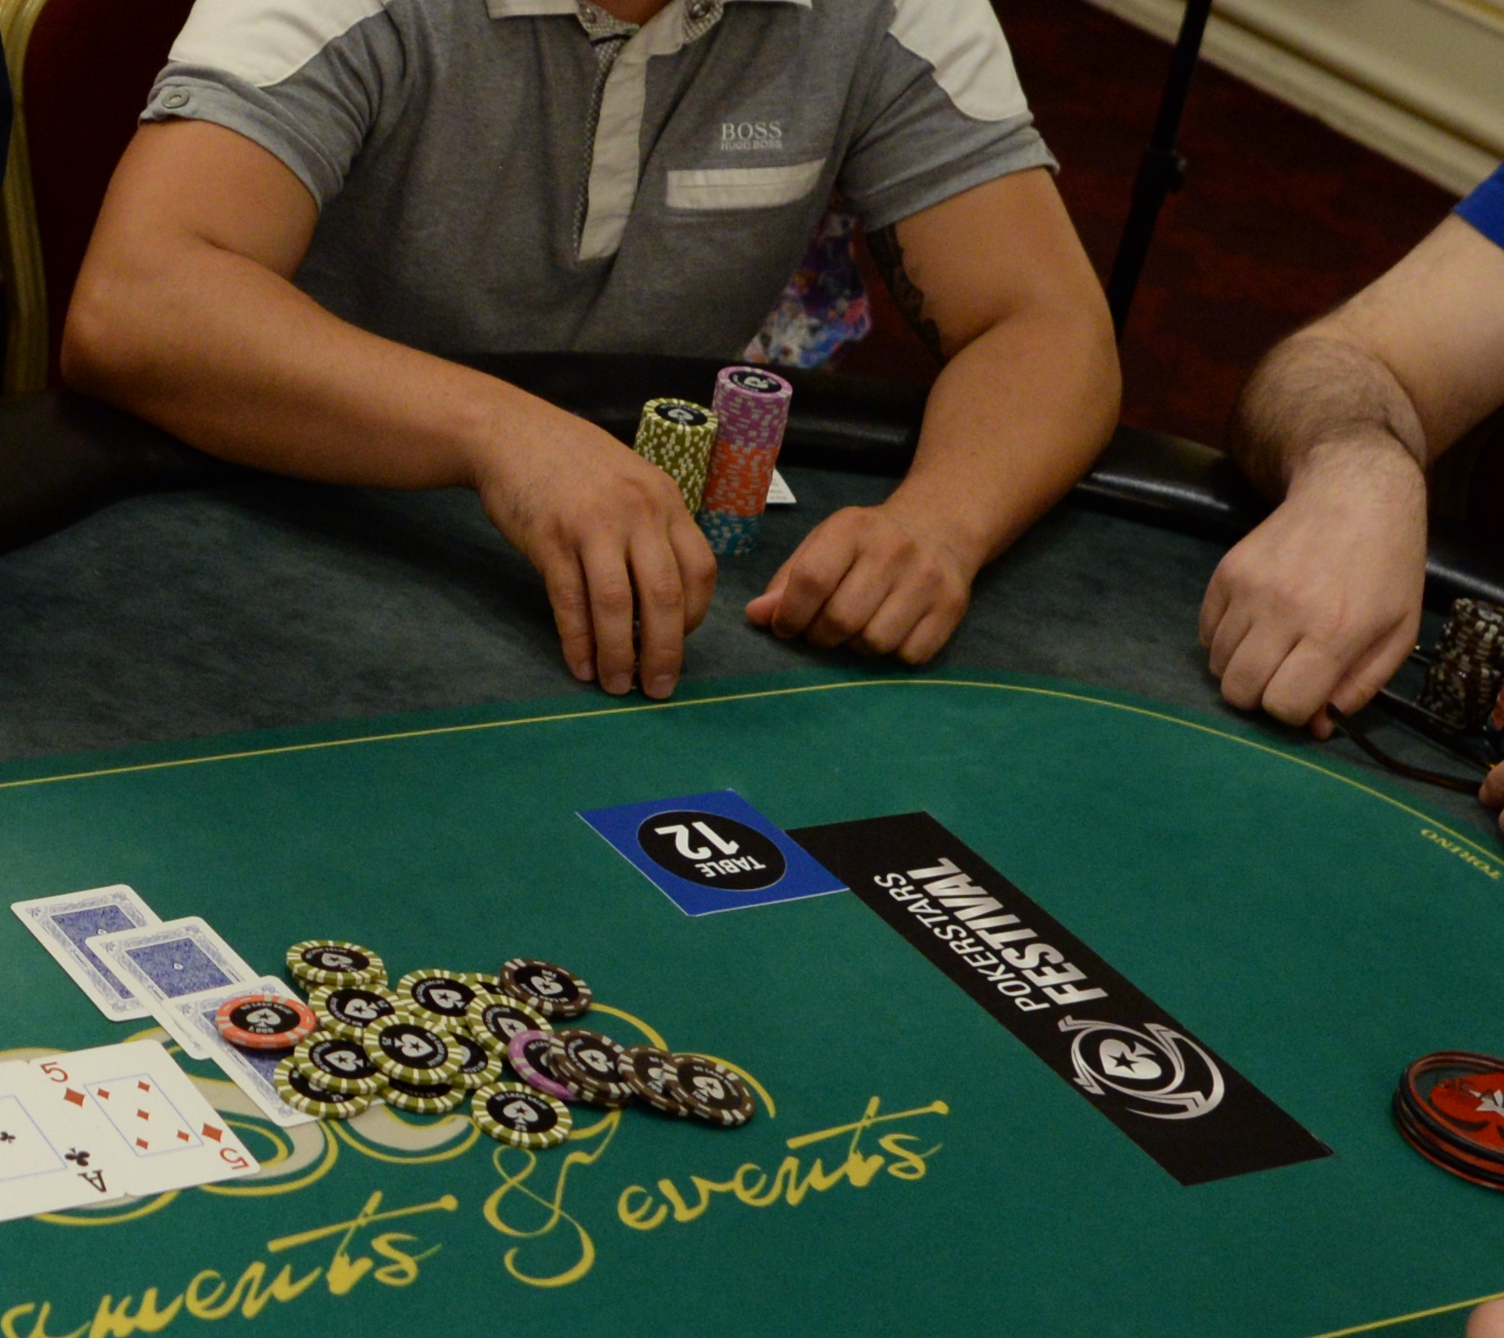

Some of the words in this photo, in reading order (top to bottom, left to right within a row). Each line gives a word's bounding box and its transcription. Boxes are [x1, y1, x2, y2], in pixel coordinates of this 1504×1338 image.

[721, 121, 782, 140] BOSS
[653, 819, 741, 862] 12
[1420, 828, 1502, 879] TORINO
[694, 853, 768, 879] TABLE
[872, 871, 1052, 1013] POKERSTARS
[904, 856, 1109, 1008] FESTIVAL
[39, 1061, 69, 1084] 5
[219, 1146, 251, 1172] 5
[76, 1169, 108, 1194] A
[482, 1123, 619, 1288] &
[614, 1094, 950, 1232] events
